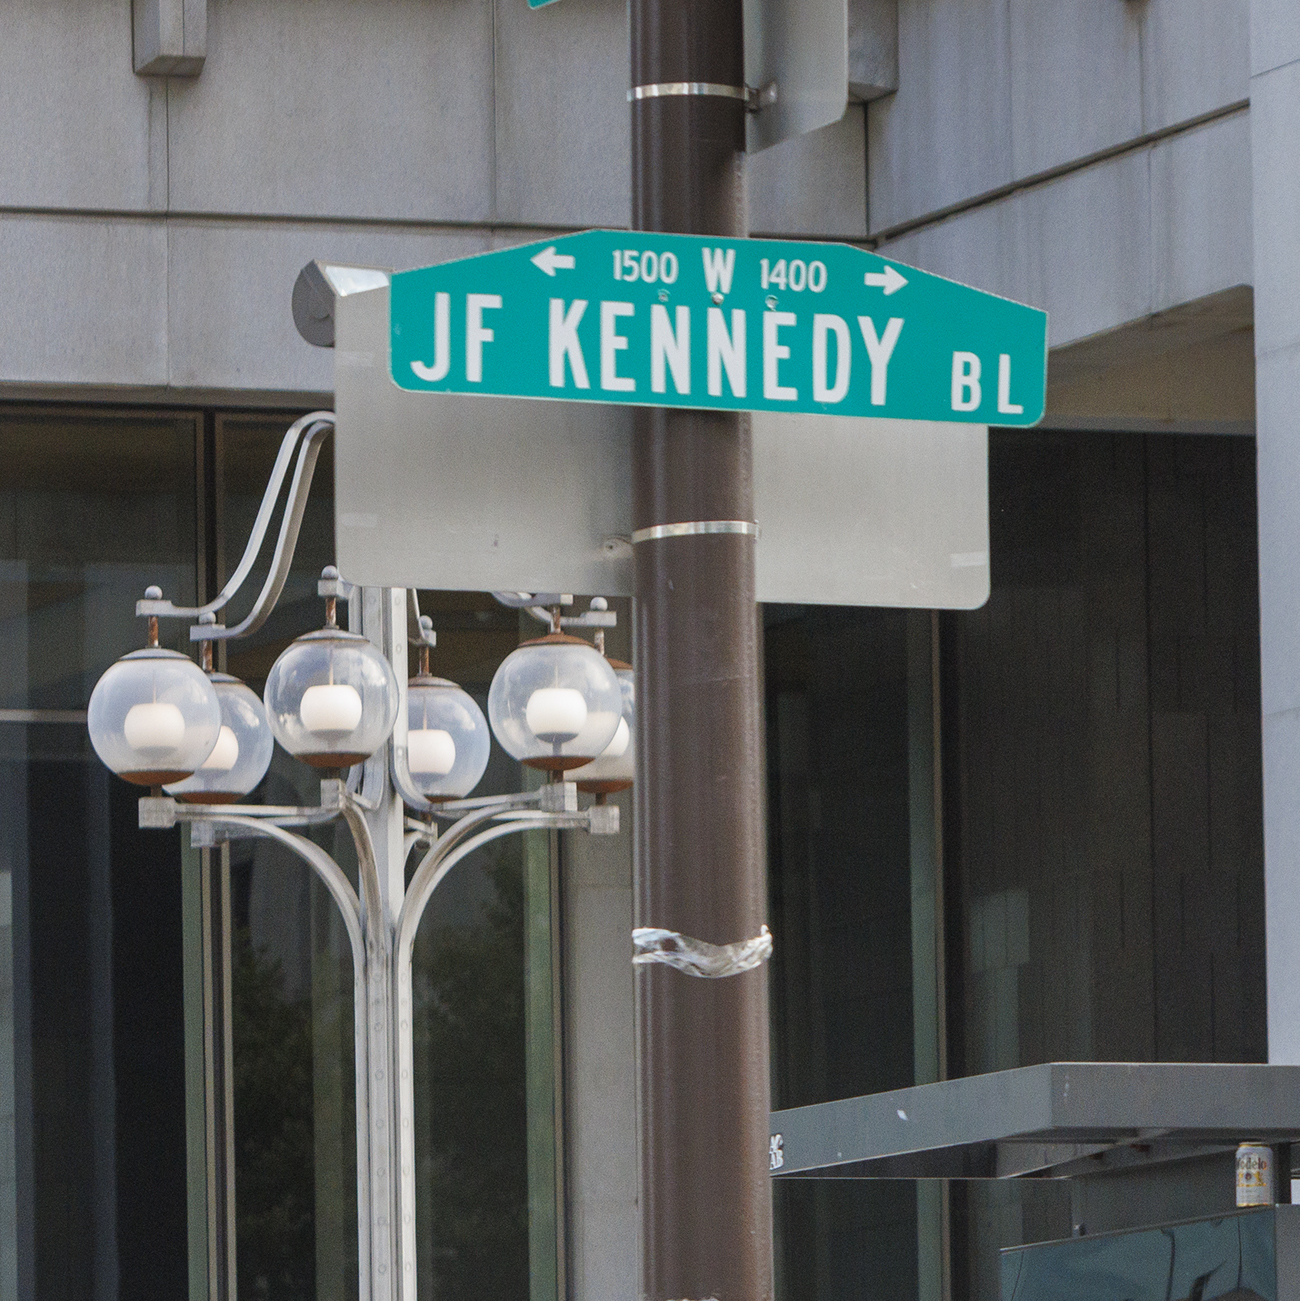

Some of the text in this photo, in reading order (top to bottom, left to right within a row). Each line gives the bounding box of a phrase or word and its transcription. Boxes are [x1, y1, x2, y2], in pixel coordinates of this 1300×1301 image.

[612, 247, 828, 294] 1500 W 1400
[411, 292, 1025, 416] JF KENNEDY BL
